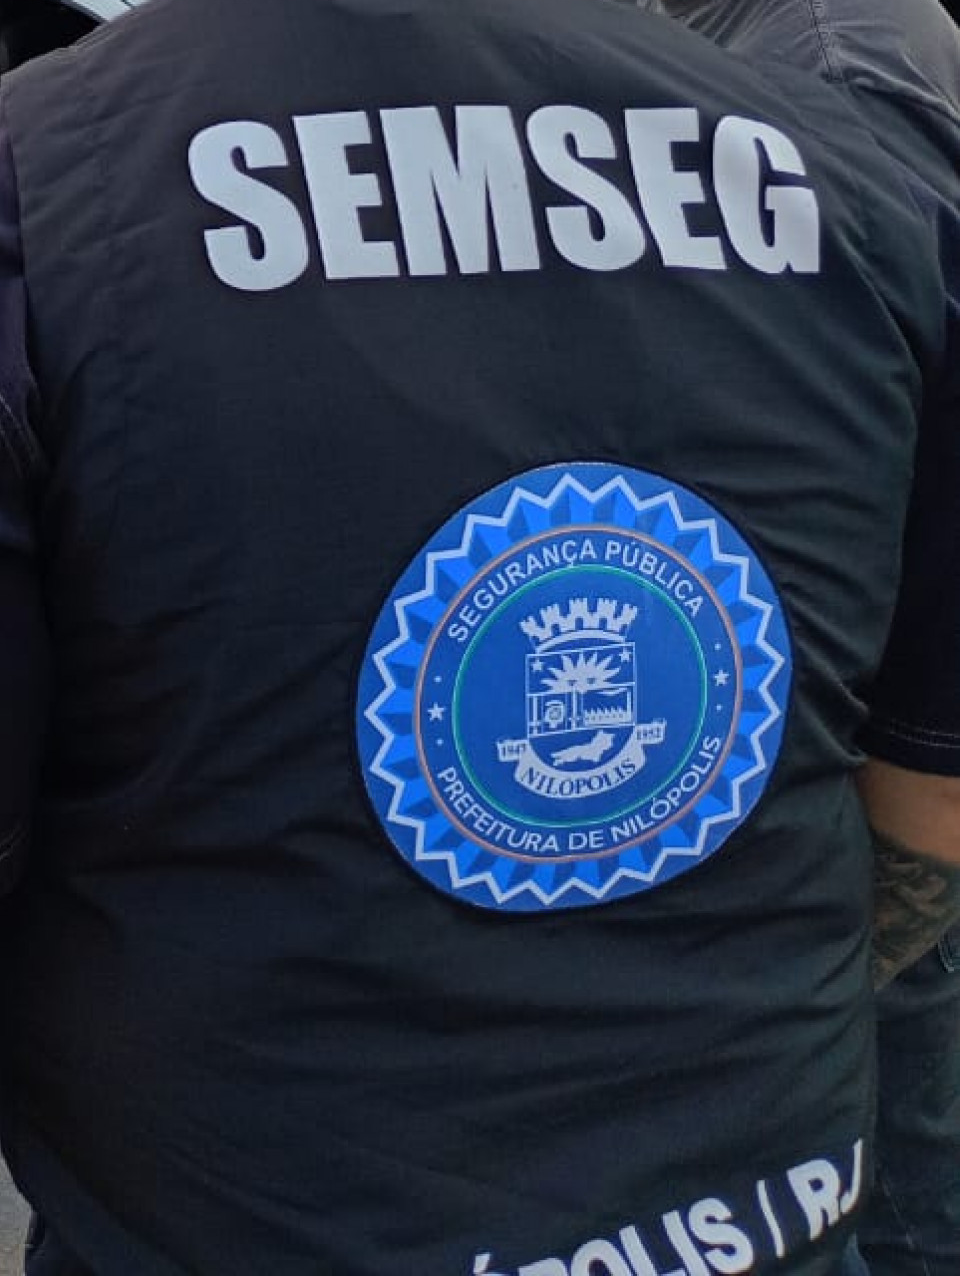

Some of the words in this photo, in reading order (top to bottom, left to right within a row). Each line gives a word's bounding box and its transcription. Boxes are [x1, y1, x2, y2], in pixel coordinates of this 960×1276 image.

[187, 105, 821, 292] SEMSEG
[448, 538, 598, 642] SEGURANÇA
[605, 540, 705, 616] PÚBLICA
[437, 766, 559, 853] PREFEITURA
[568, 830, 605, 851] DE
[611, 735, 722, 845] NILÓPOLIS
